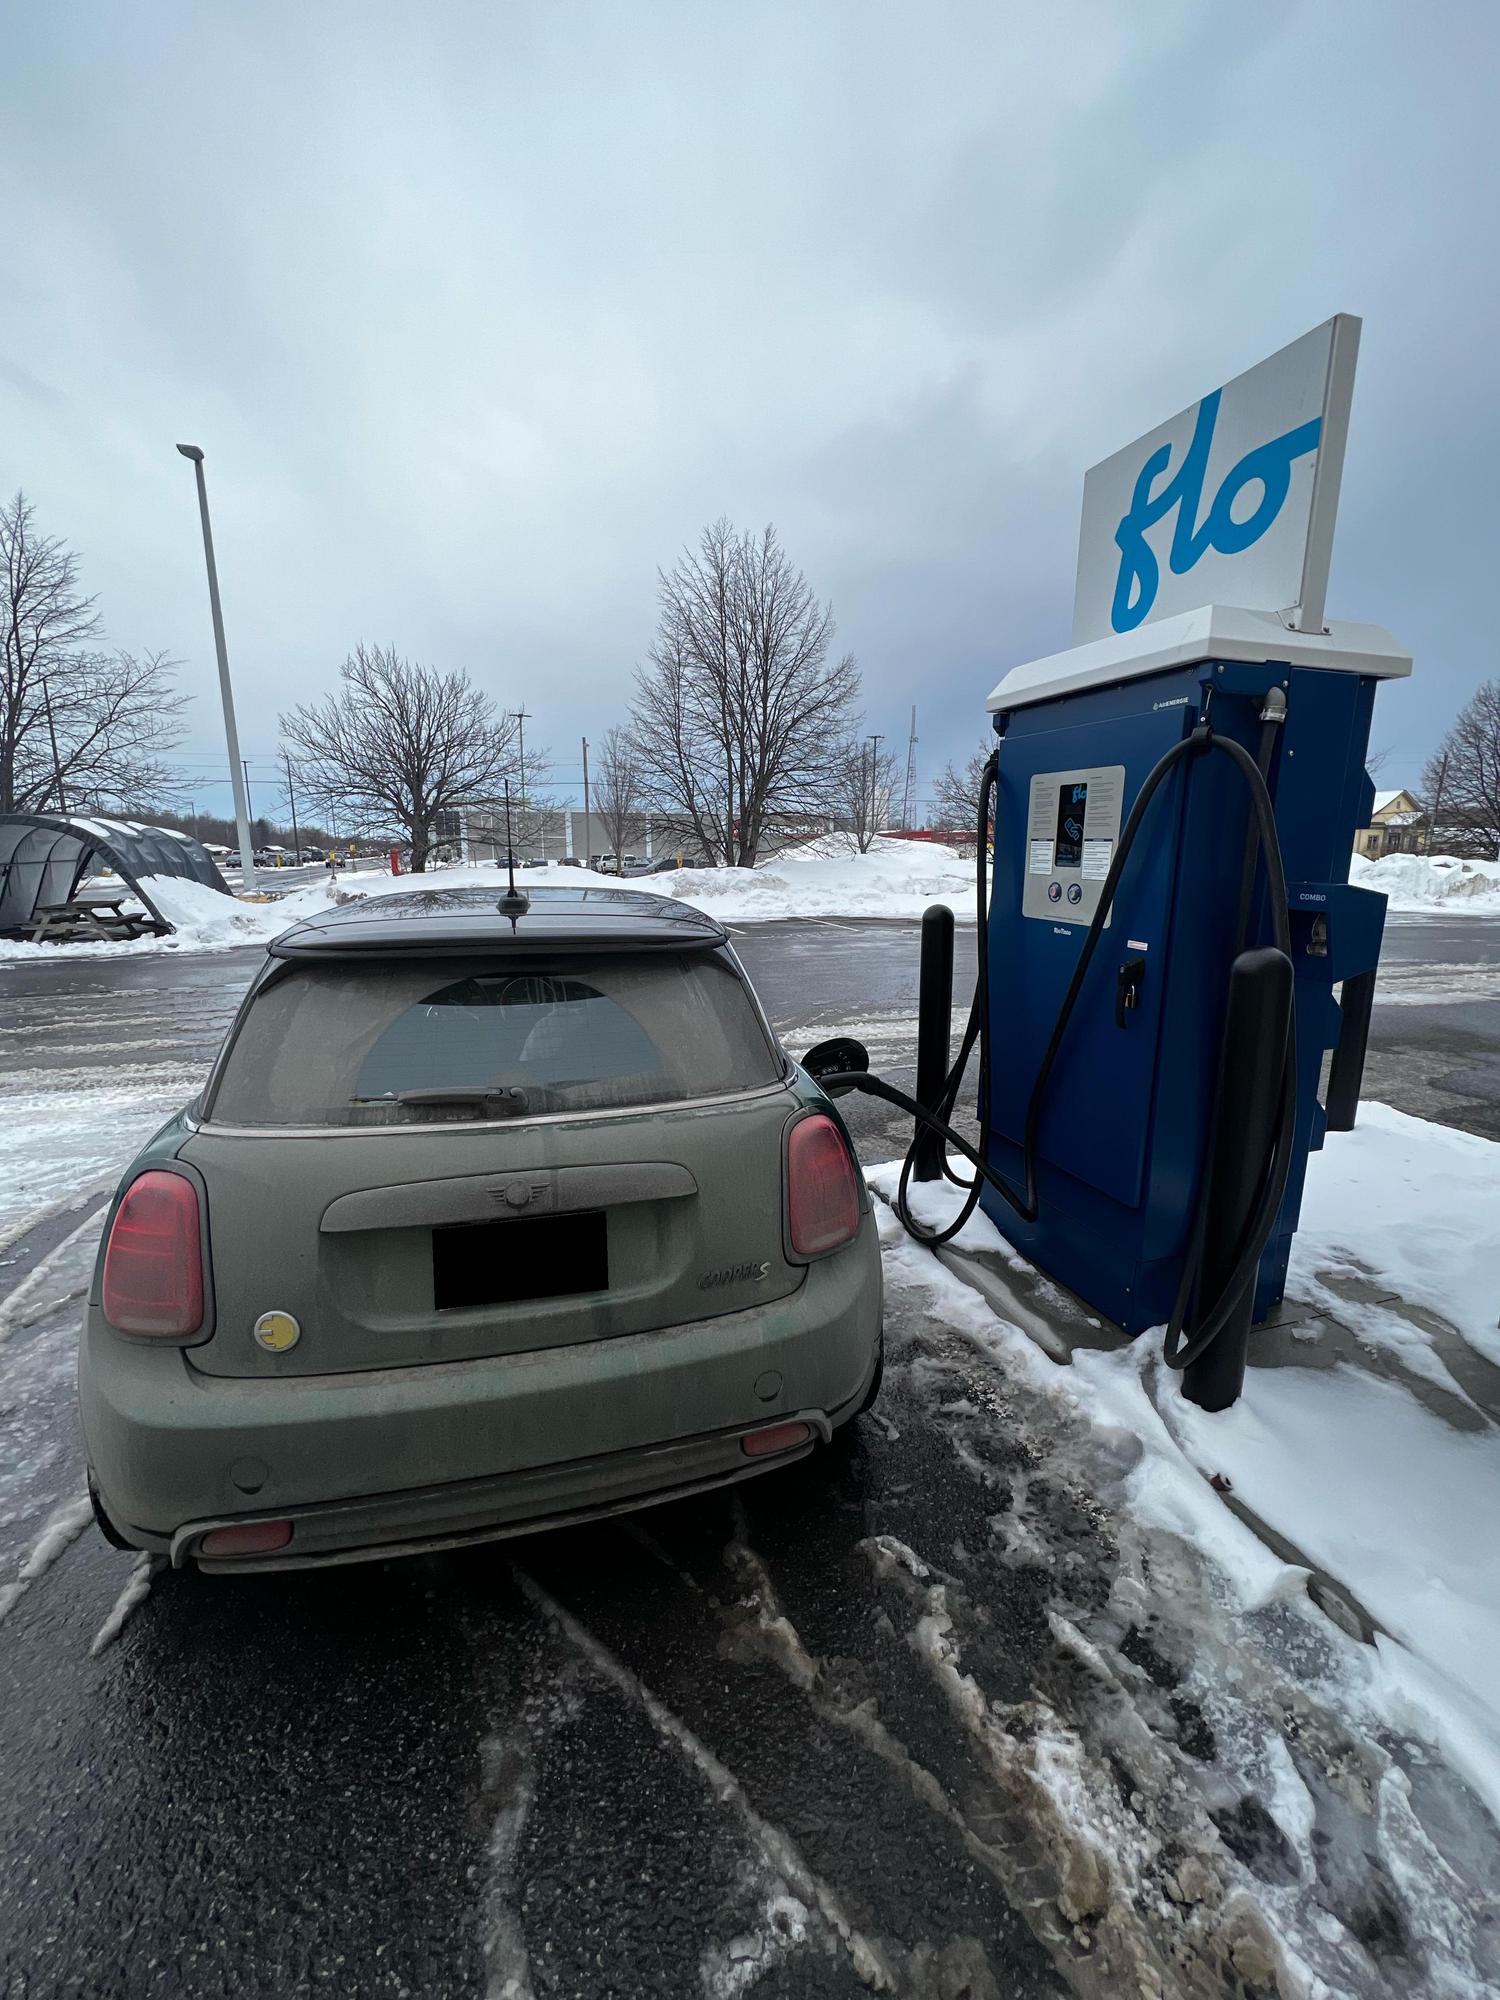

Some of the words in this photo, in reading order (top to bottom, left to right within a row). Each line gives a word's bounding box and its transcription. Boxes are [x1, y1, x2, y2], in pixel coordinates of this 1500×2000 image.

[1111, 387, 1322, 634] flo
[1072, 784, 1088, 803] flo
[1299, 893, 1327, 902] COMBO
[754, 1261, 771, 1281] S
